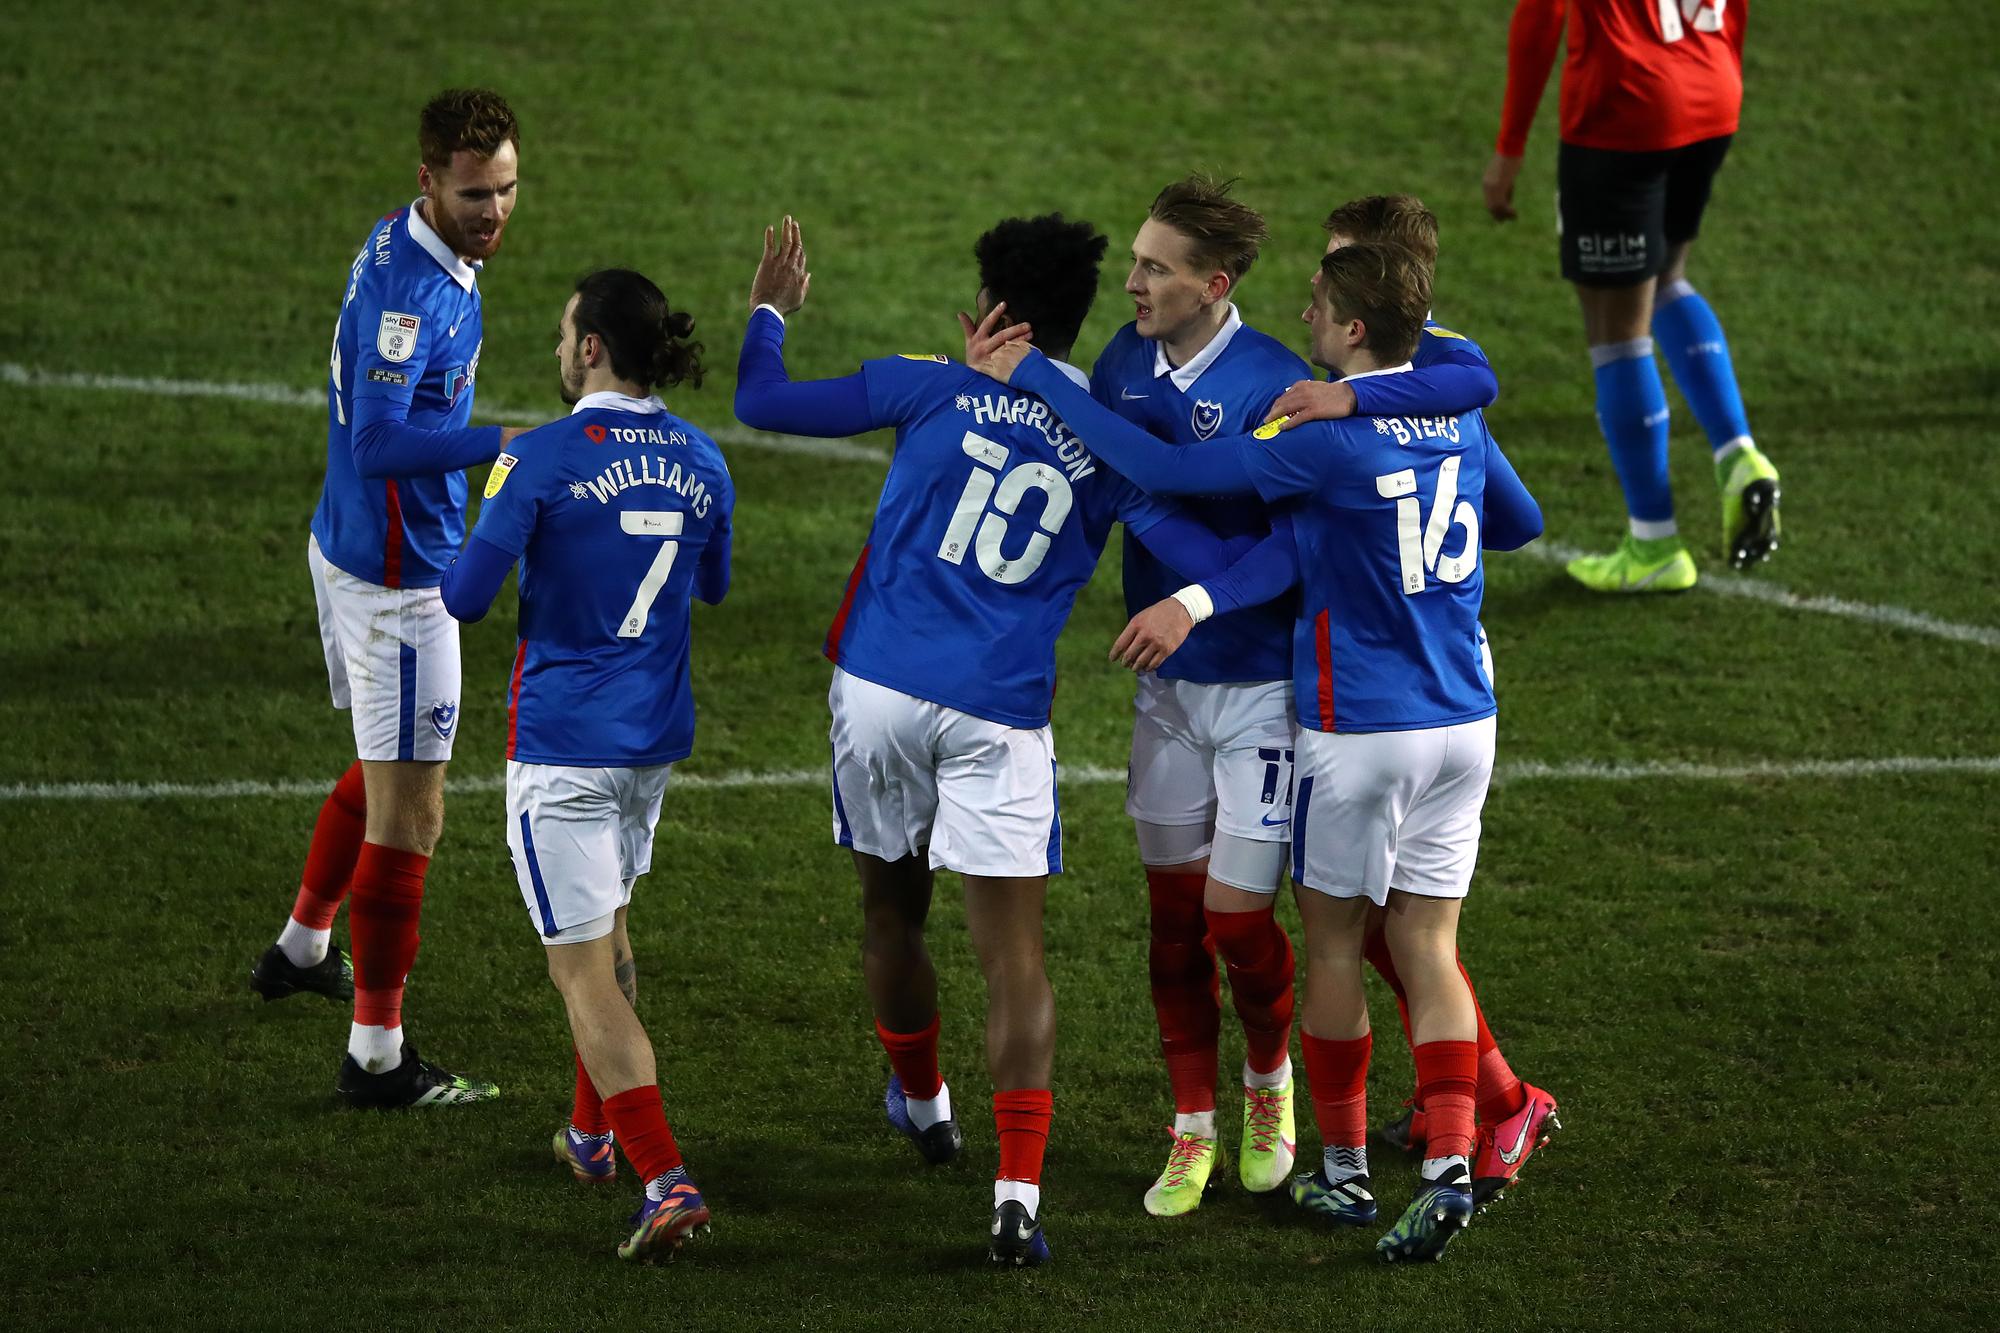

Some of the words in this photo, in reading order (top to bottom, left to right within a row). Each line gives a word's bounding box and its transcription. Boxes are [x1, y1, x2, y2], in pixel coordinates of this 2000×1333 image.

[385, 316, 398, 325] sky
[400, 318, 415, 328] bet
[388, 349, 400, 357] EFL
[610, 427, 687, 446] TOTALAV
[971, 394, 1096, 483] HARRISON
[1387, 415, 1460, 446] BYERS
[586, 454, 713, 520] WILLIAMS
[937, 430, 1073, 585] 10
[1375, 455, 1480, 596] 16
[616, 510, 684, 638] 7
